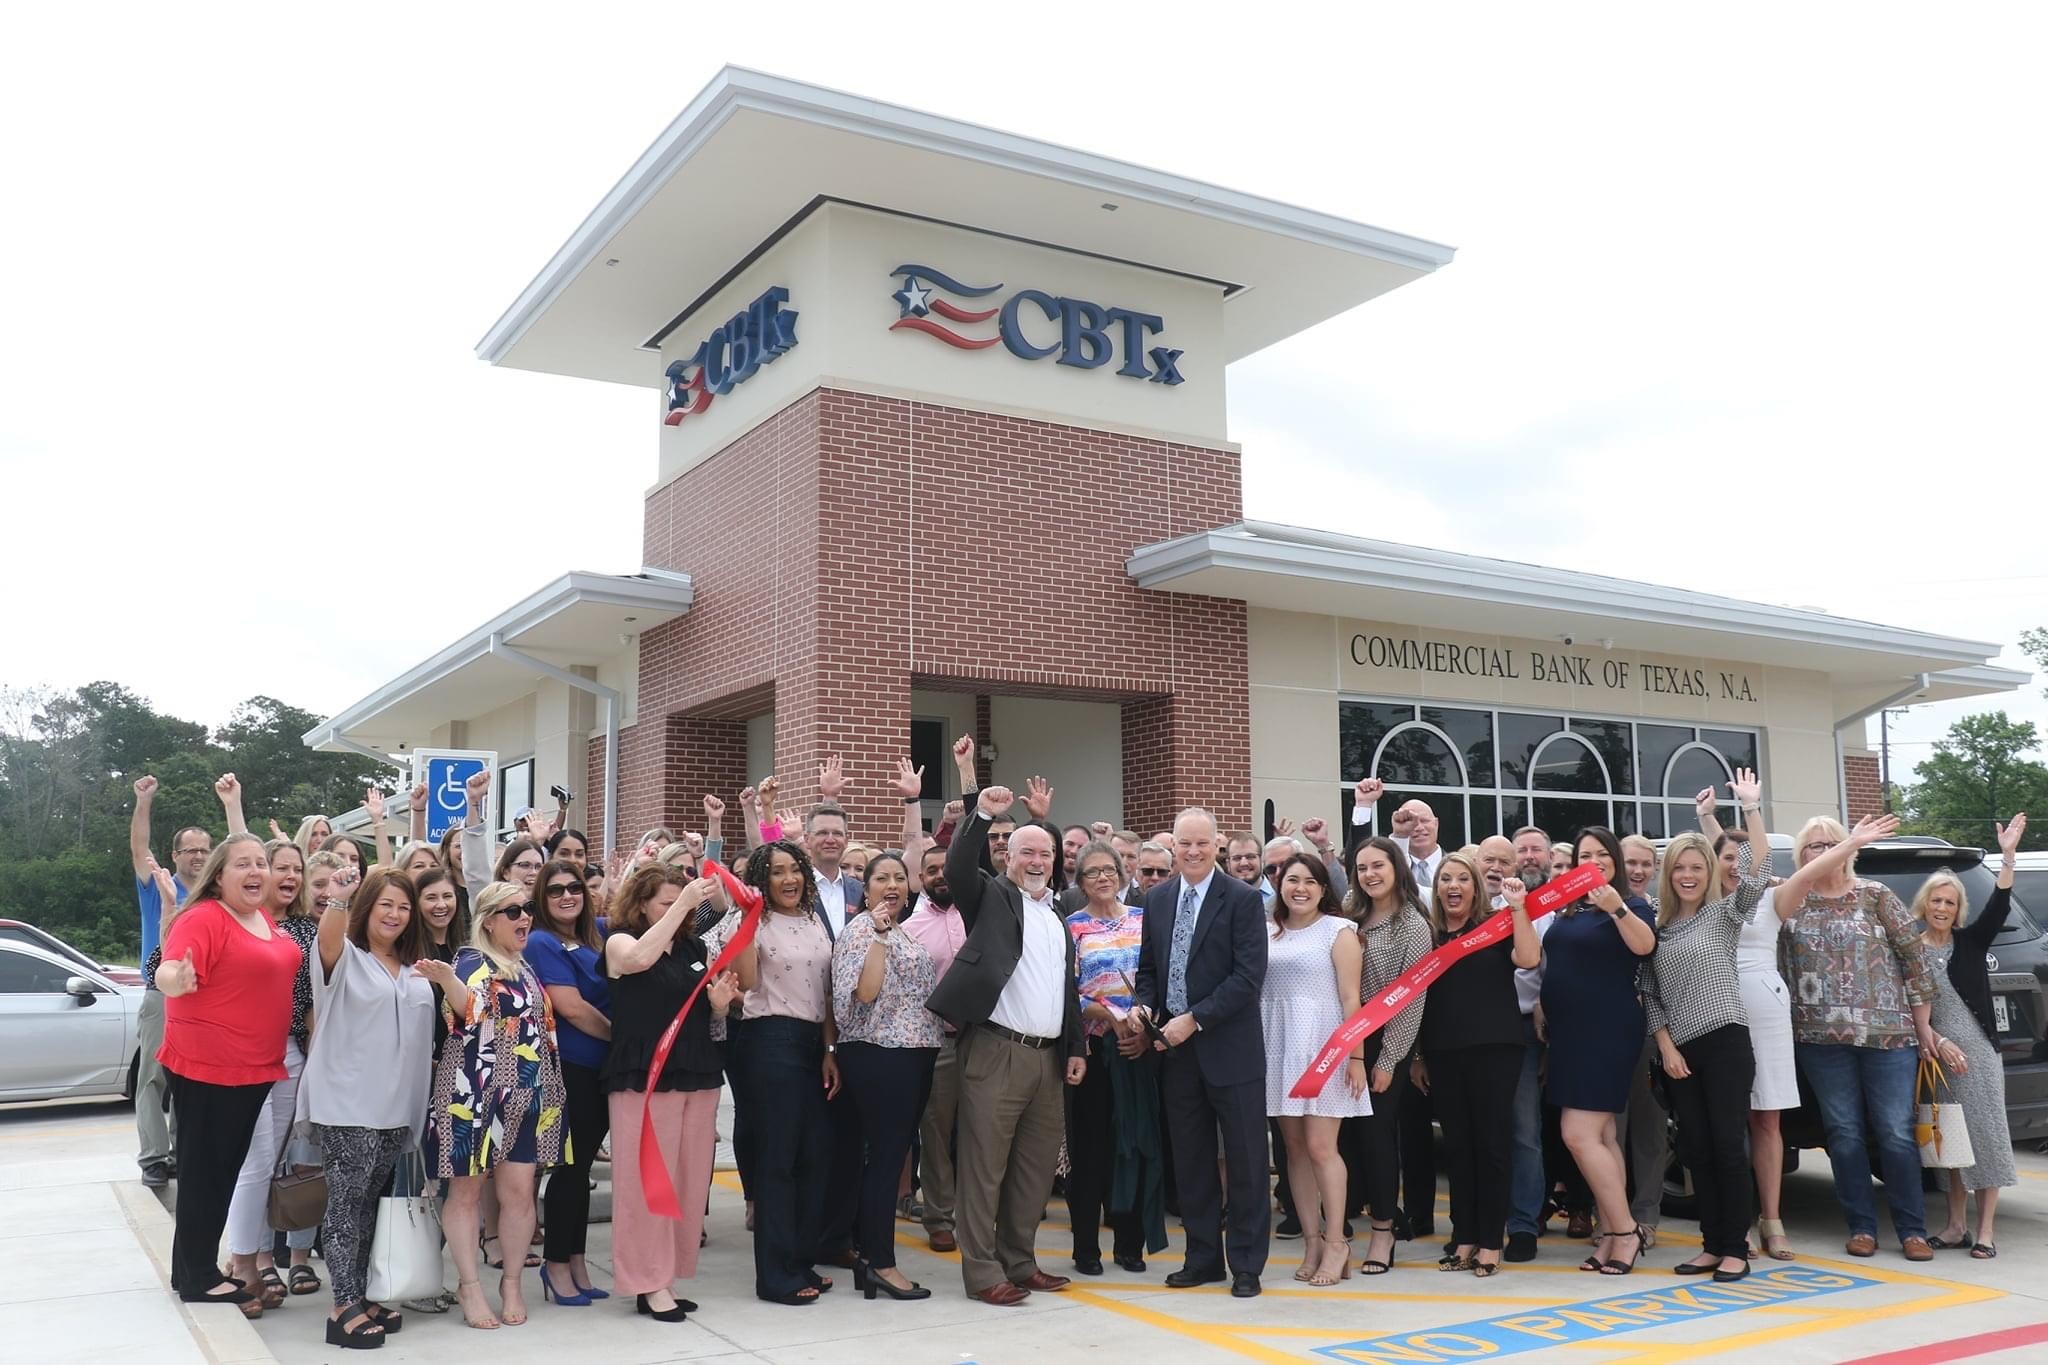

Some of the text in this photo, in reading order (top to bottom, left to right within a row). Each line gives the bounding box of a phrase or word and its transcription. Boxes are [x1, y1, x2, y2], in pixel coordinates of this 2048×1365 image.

[1351, 634, 1757, 702] COMMERCIAL BANK OF TEXAS, N.A.
[1383, 993, 1399, 1007] 100
[1315, 1059, 1331, 1075] 100
[1327, 1270, 1854, 1365] NO PARKING
